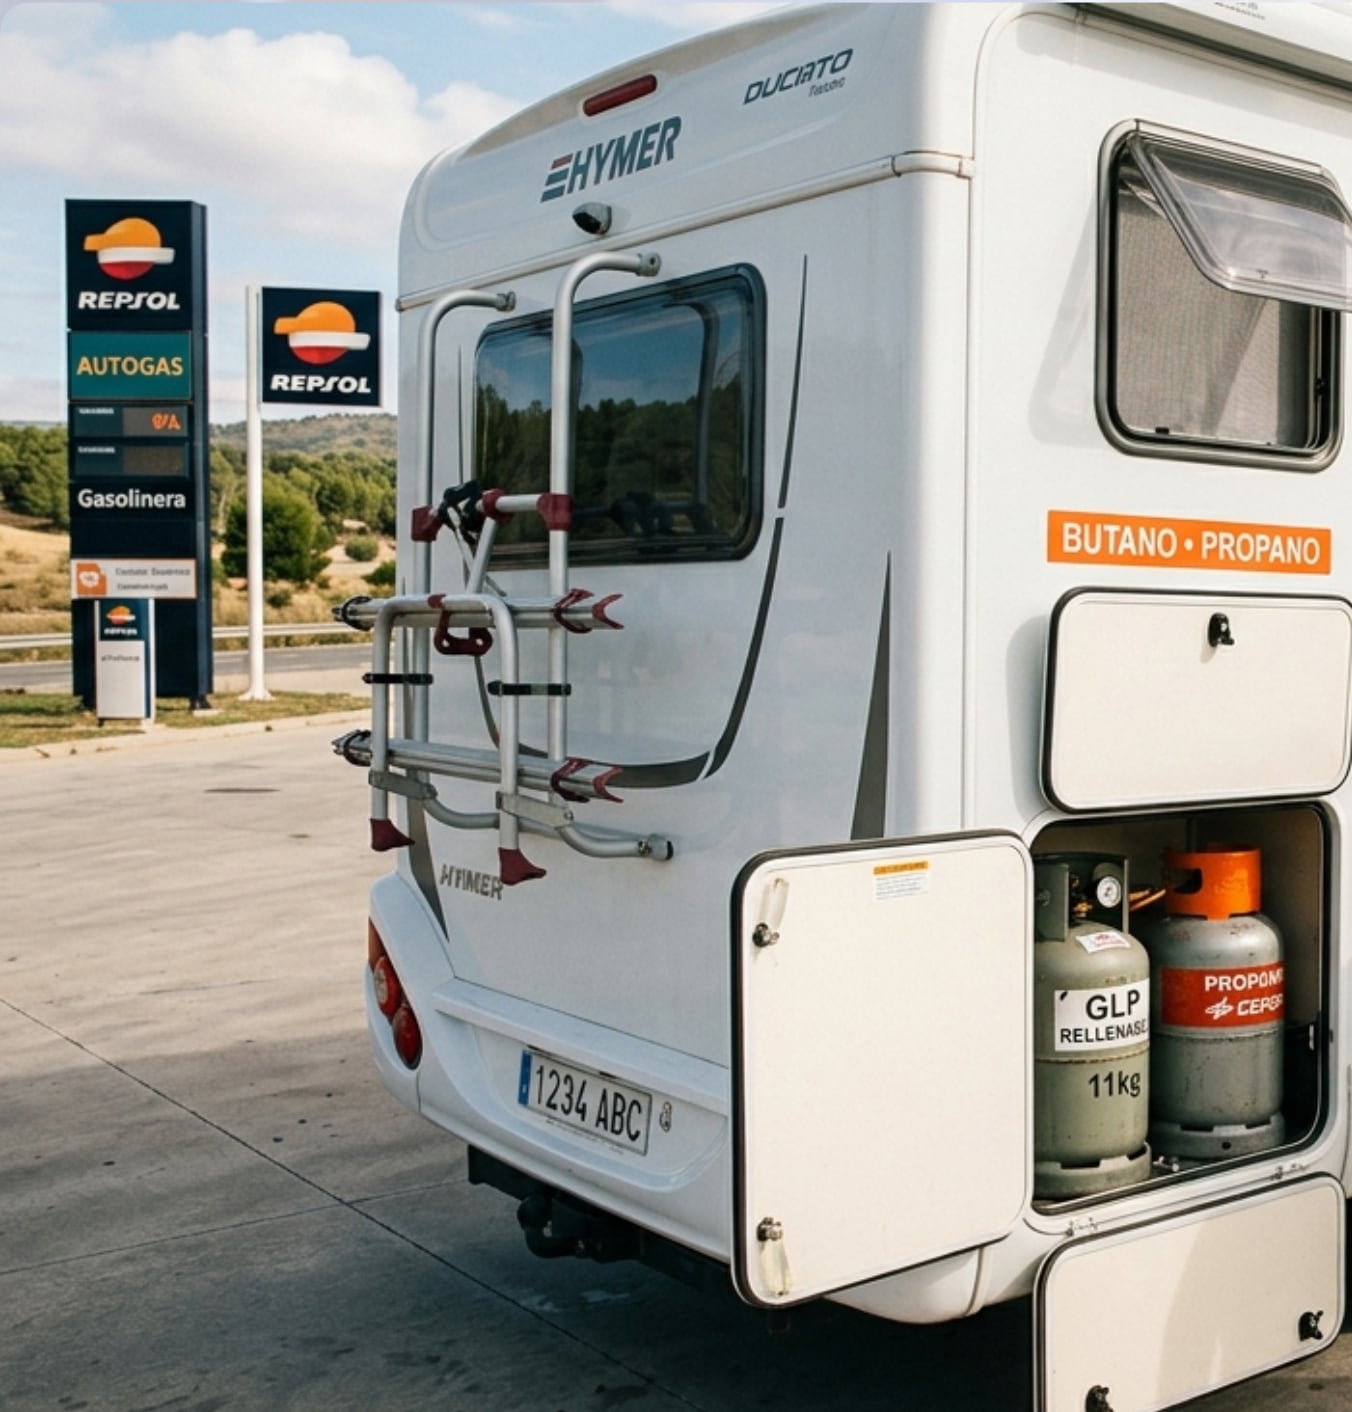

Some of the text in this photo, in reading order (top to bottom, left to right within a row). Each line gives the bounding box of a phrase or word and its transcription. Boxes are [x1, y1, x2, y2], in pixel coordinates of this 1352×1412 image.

[78, 291, 180, 310] REPSOL
[76, 356, 184, 376] AUTOGAS
[270, 374, 371, 393] REPSOL
[77, 488, 186, 508] Gasolinera
[1062, 522, 1178, 559] BUTANO
[1201, 530, 1321, 565] PROPANO
[1086, 989, 1140, 1021] GLP
[1088, 1071, 1141, 1098] 11kg
[535, 1065, 588, 1122] 1234
[595, 1087, 643, 1142] ABC
